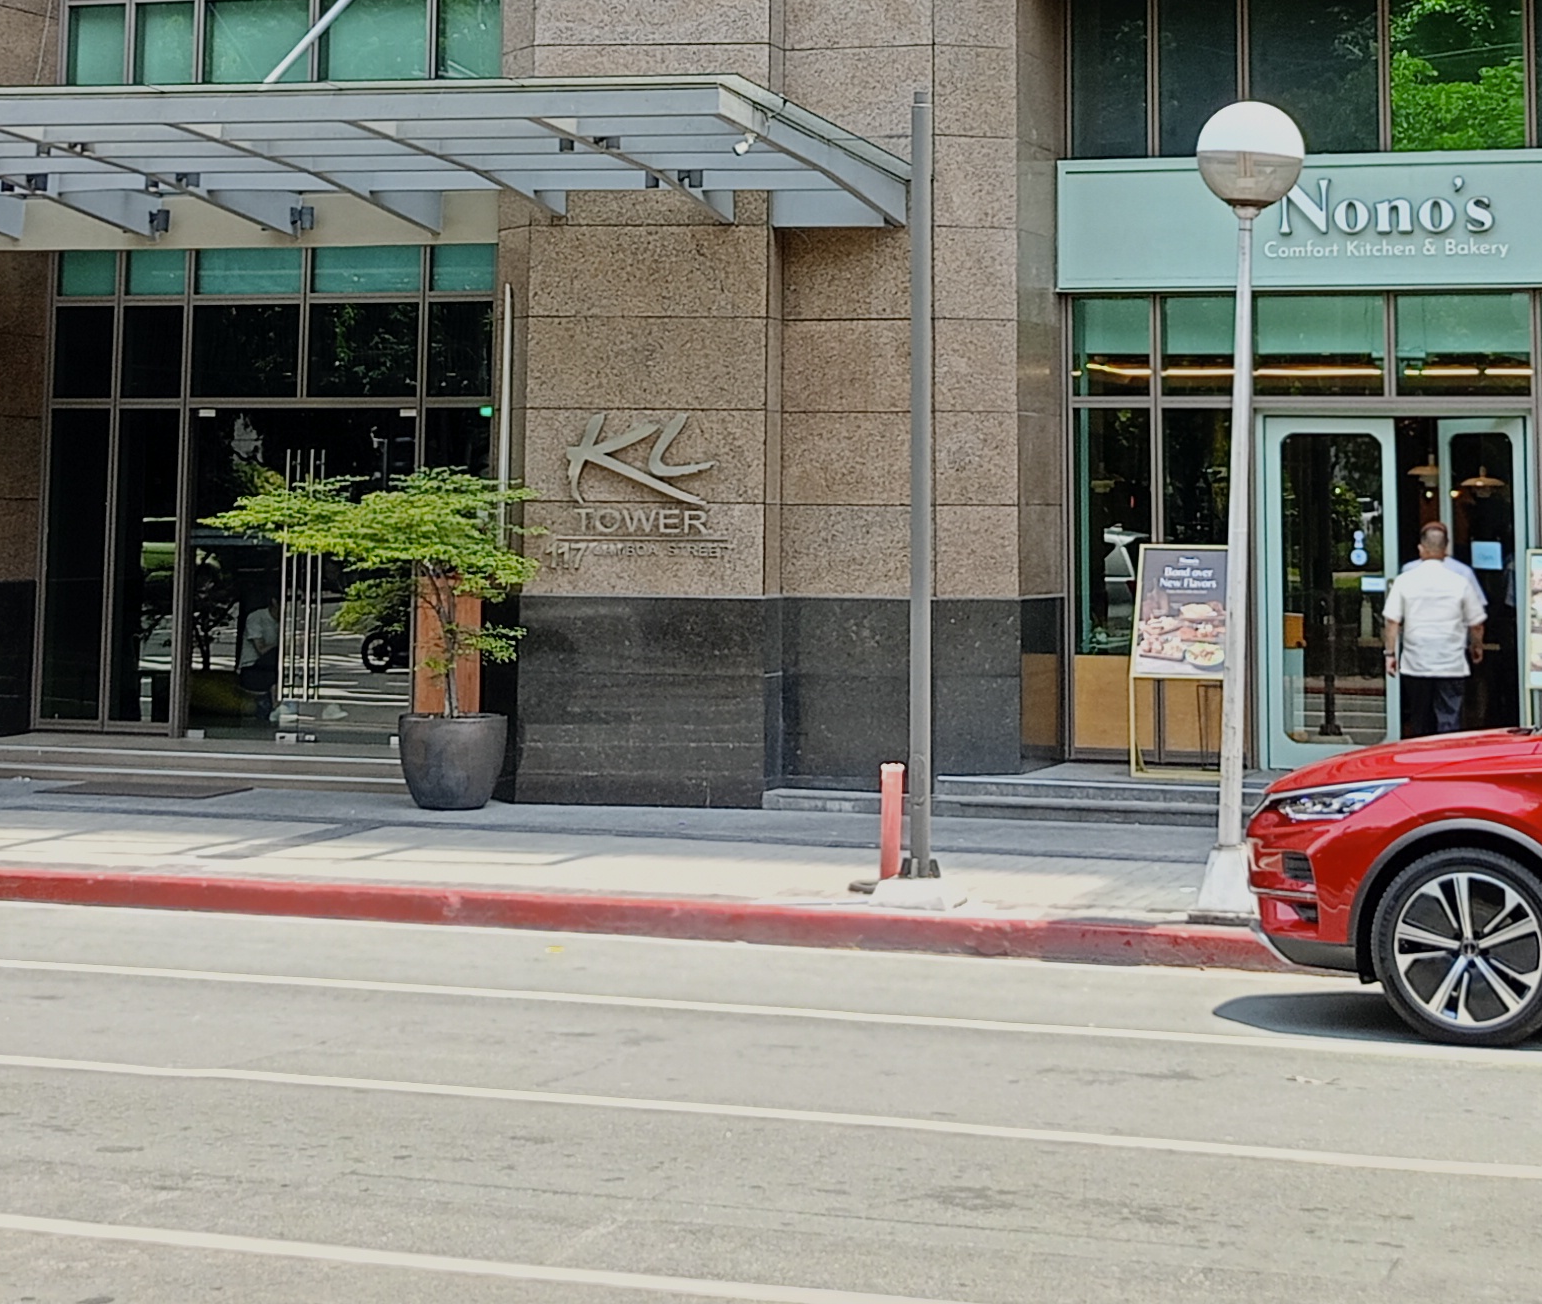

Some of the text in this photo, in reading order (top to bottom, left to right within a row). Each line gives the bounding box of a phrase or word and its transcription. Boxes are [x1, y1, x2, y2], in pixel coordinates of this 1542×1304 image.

[1279, 176, 1495, 235] Nono's
[1264, 238, 1509, 258] Comfort Kitchen & Bakery
[566, 413, 717, 505] KL
[573, 508, 709, 534] TOWER
[1159, 577, 1217, 588] New Flavors
[1164, 566, 1213, 577] Bond over
